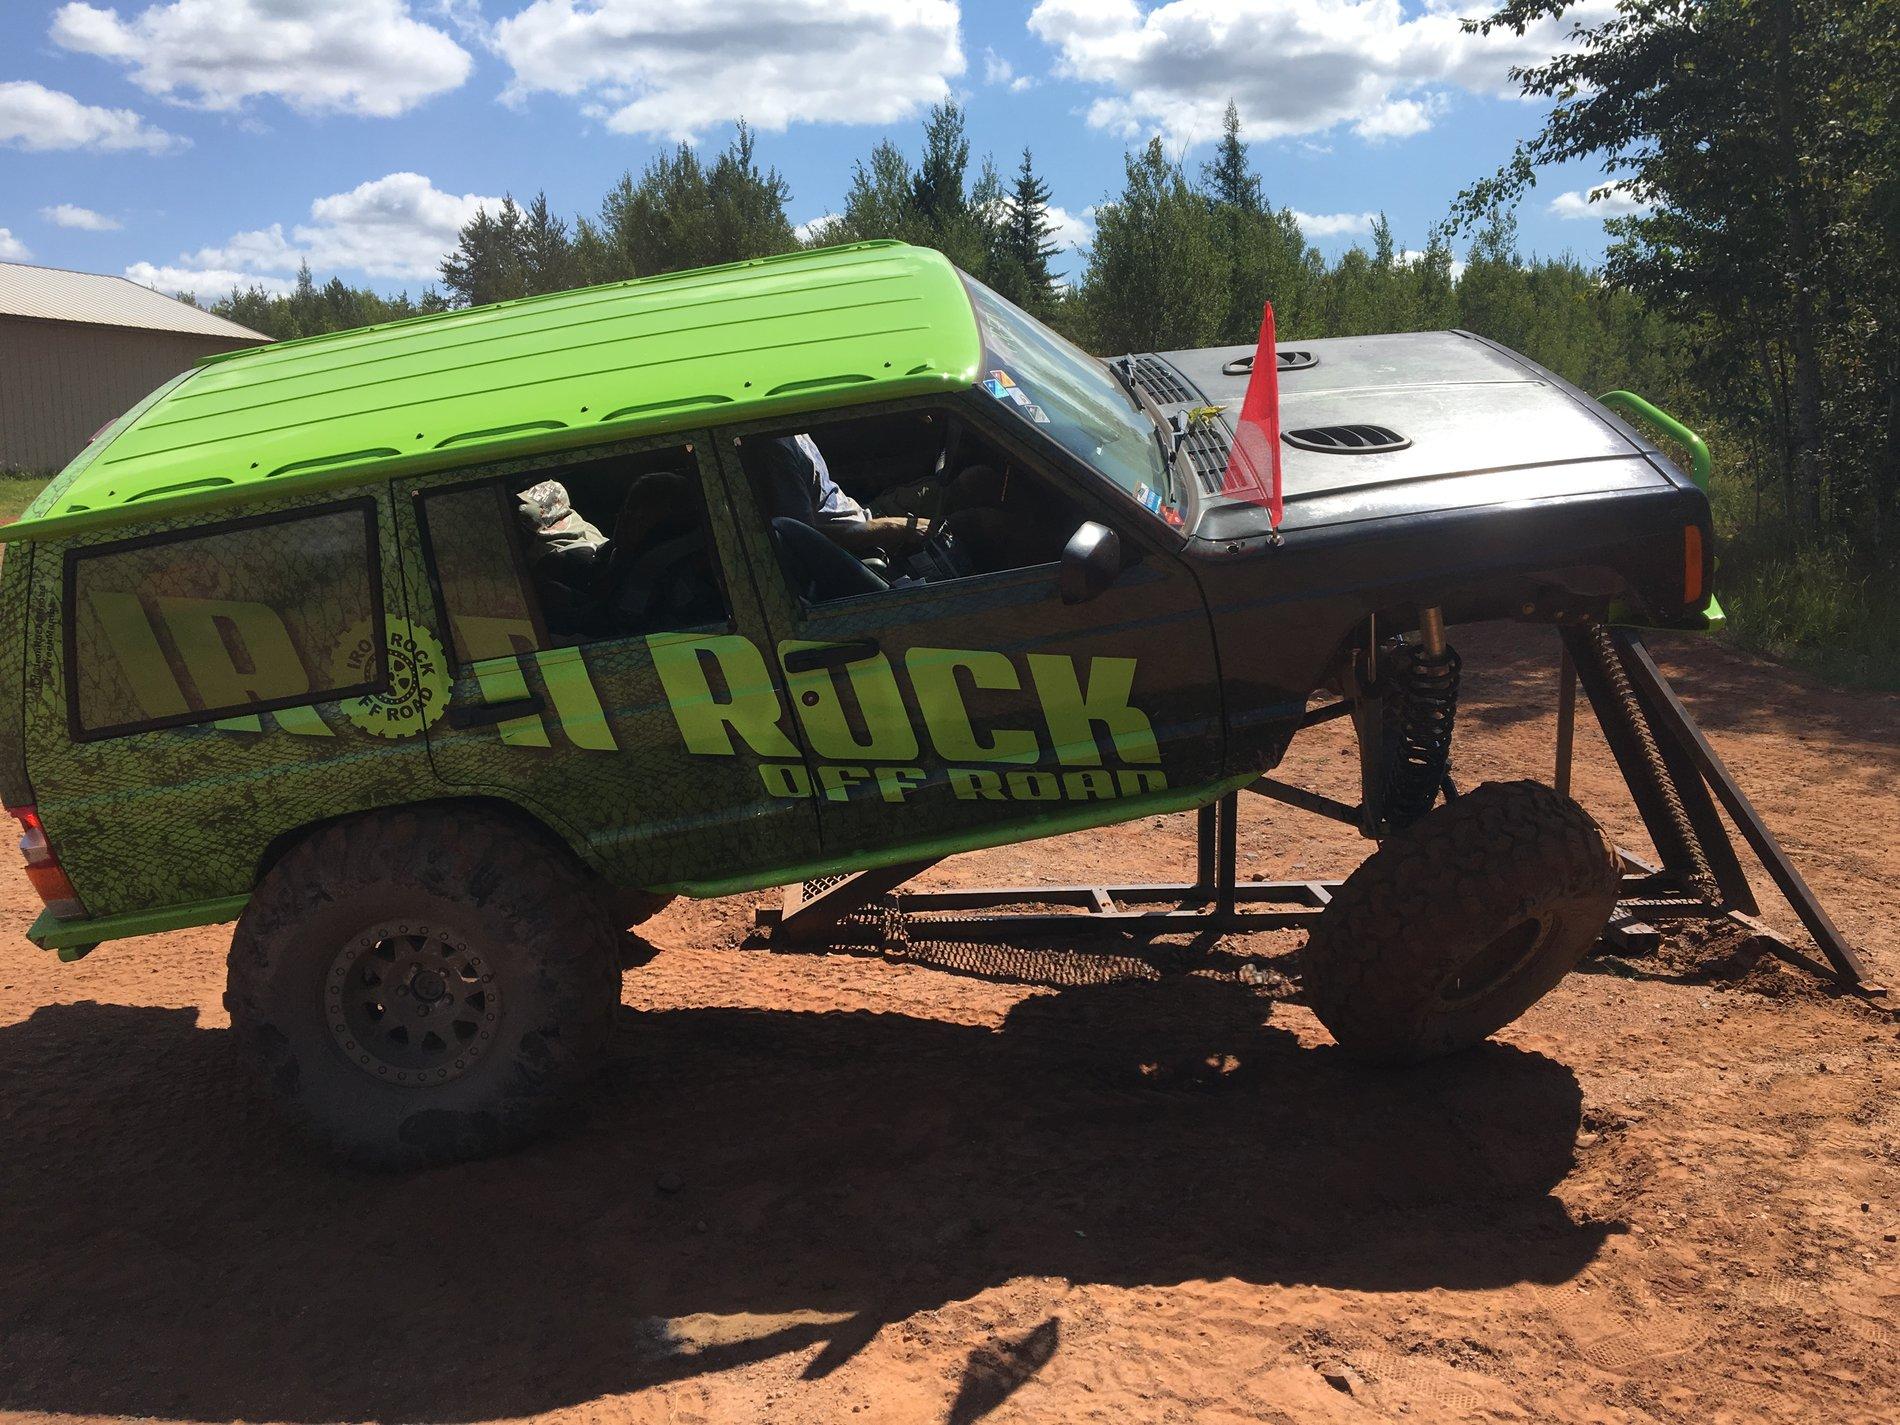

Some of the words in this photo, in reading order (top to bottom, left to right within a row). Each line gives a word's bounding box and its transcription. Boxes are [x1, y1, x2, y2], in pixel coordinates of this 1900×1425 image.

[390, 632, 436, 677] ROCK
[358, 693, 383, 717] FF
[386, 686, 433, 722] ROAD
[645, 632, 1161, 766] ROCK
[758, 764, 927, 802] OFF
[947, 768, 1168, 801] ROAD
